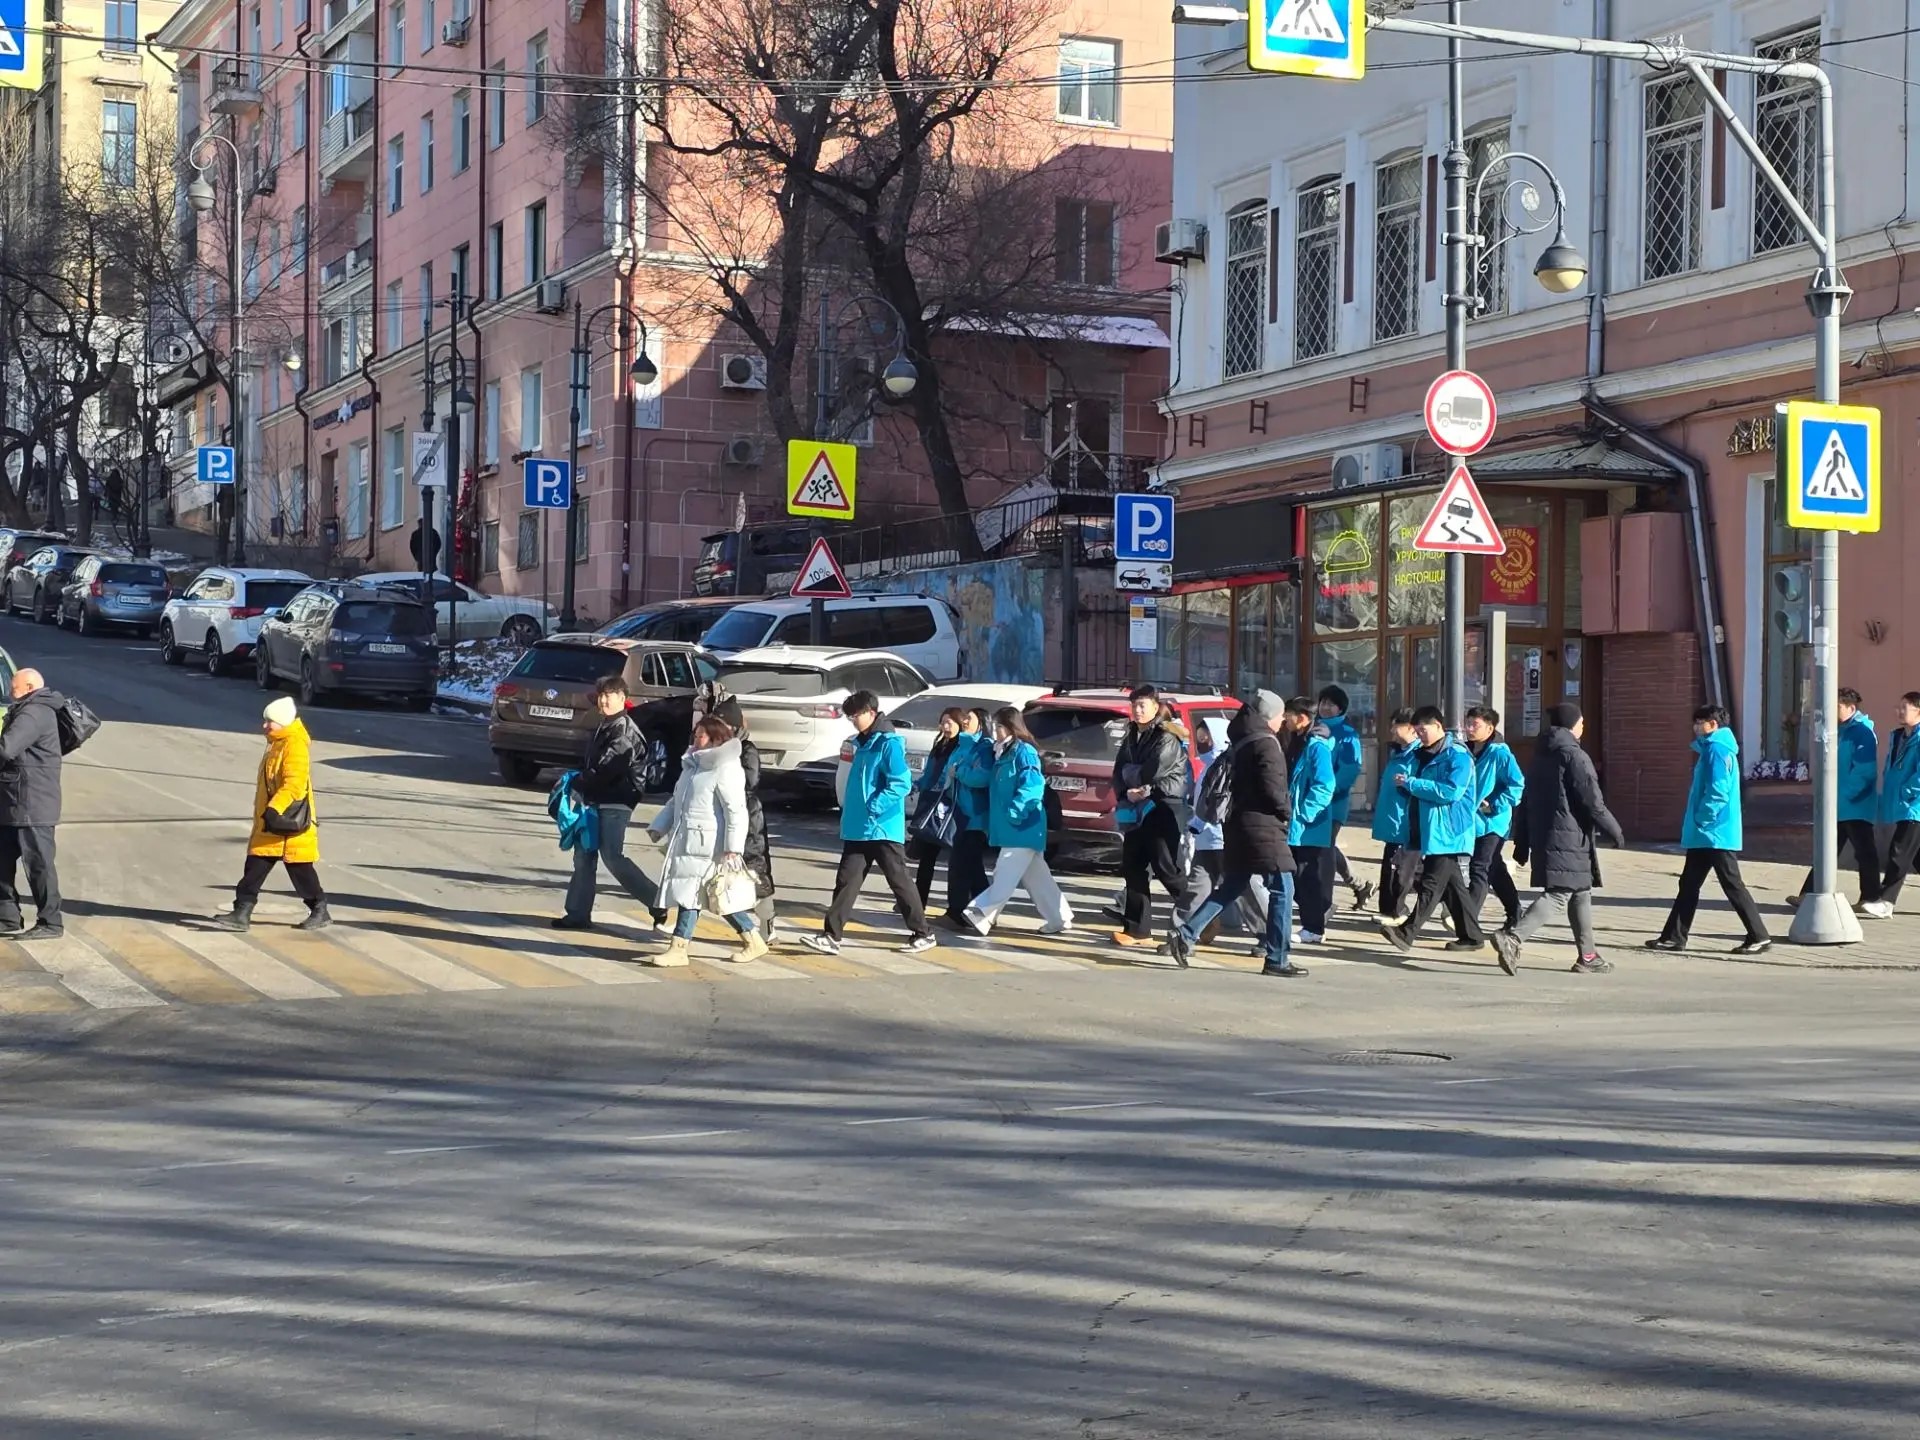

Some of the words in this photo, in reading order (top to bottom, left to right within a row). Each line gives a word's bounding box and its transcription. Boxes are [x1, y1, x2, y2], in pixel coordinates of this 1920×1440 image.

[207, 450, 227, 478] P
[421, 454, 436, 467] 40
[537, 464, 561, 502] P
[1131, 503, 1163, 552] P
[1401, 527, 1420, 540] ВКУ
[809, 567, 831, 584] 10%
